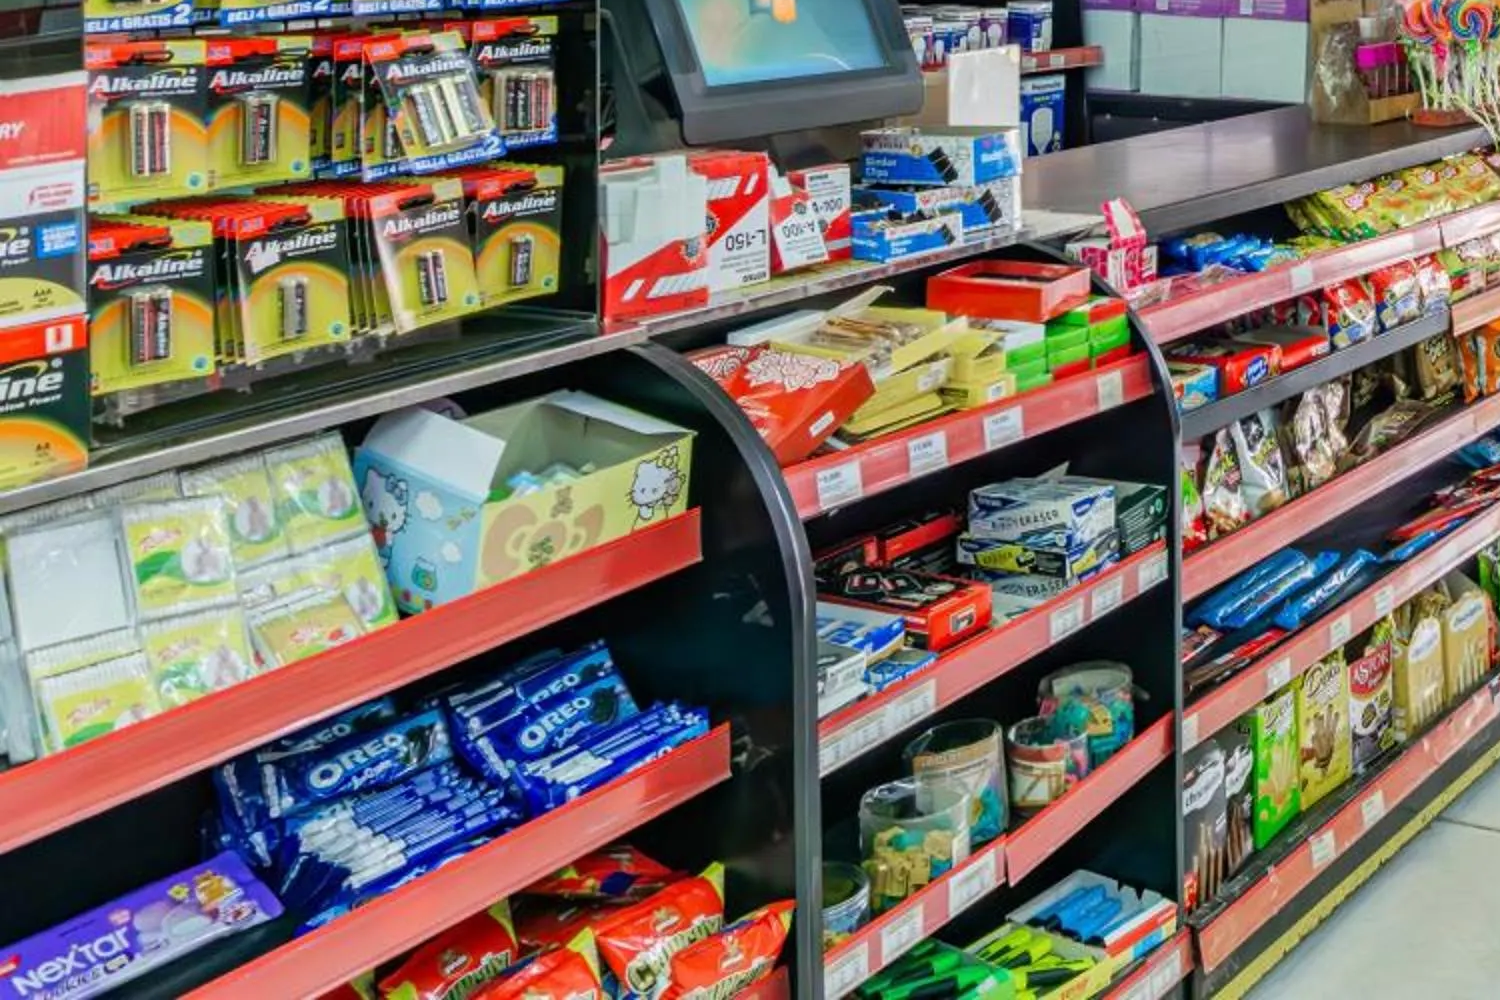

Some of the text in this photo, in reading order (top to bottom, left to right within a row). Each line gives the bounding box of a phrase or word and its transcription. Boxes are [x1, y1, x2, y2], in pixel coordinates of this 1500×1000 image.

[109, 16, 120, 31] 4
[173, 3, 192, 25] 2
[478, 42, 552, 61] Alkaline
[209, 67, 305, 89] Alkaline
[386, 57, 467, 80] Alkaline
[89, 72, 198, 95] Alkaline
[485, 135, 500, 154] 2
[482, 194, 556, 219] Alkaline
[383, 206, 460, 237] Alkaline
[725, 228, 767, 251] L-150
[89, 255, 204, 284] Alkaline
[519, 696, 592, 749] OREO
[307, 731, 405, 789] OREO
